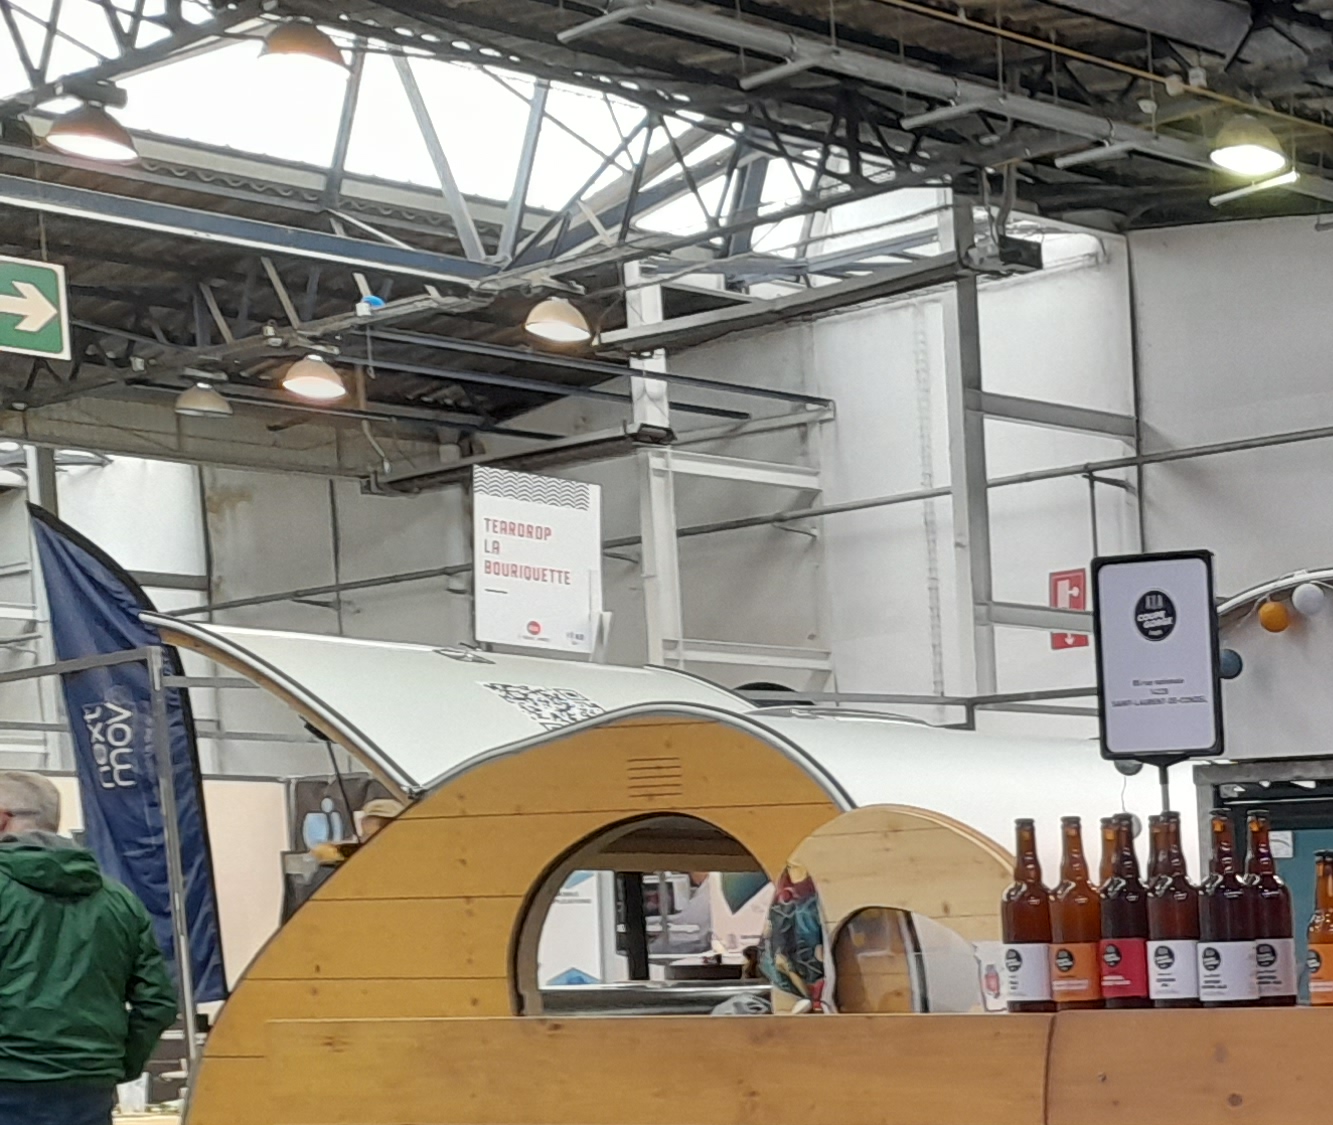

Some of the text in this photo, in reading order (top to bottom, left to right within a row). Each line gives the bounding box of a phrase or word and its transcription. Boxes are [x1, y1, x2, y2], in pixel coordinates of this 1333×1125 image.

[483, 517, 552, 541] TEARDROP
[484, 538, 500, 555] LA
[484, 560, 571, 585] BOURIQUETTE
[104, 702, 137, 787] mov
